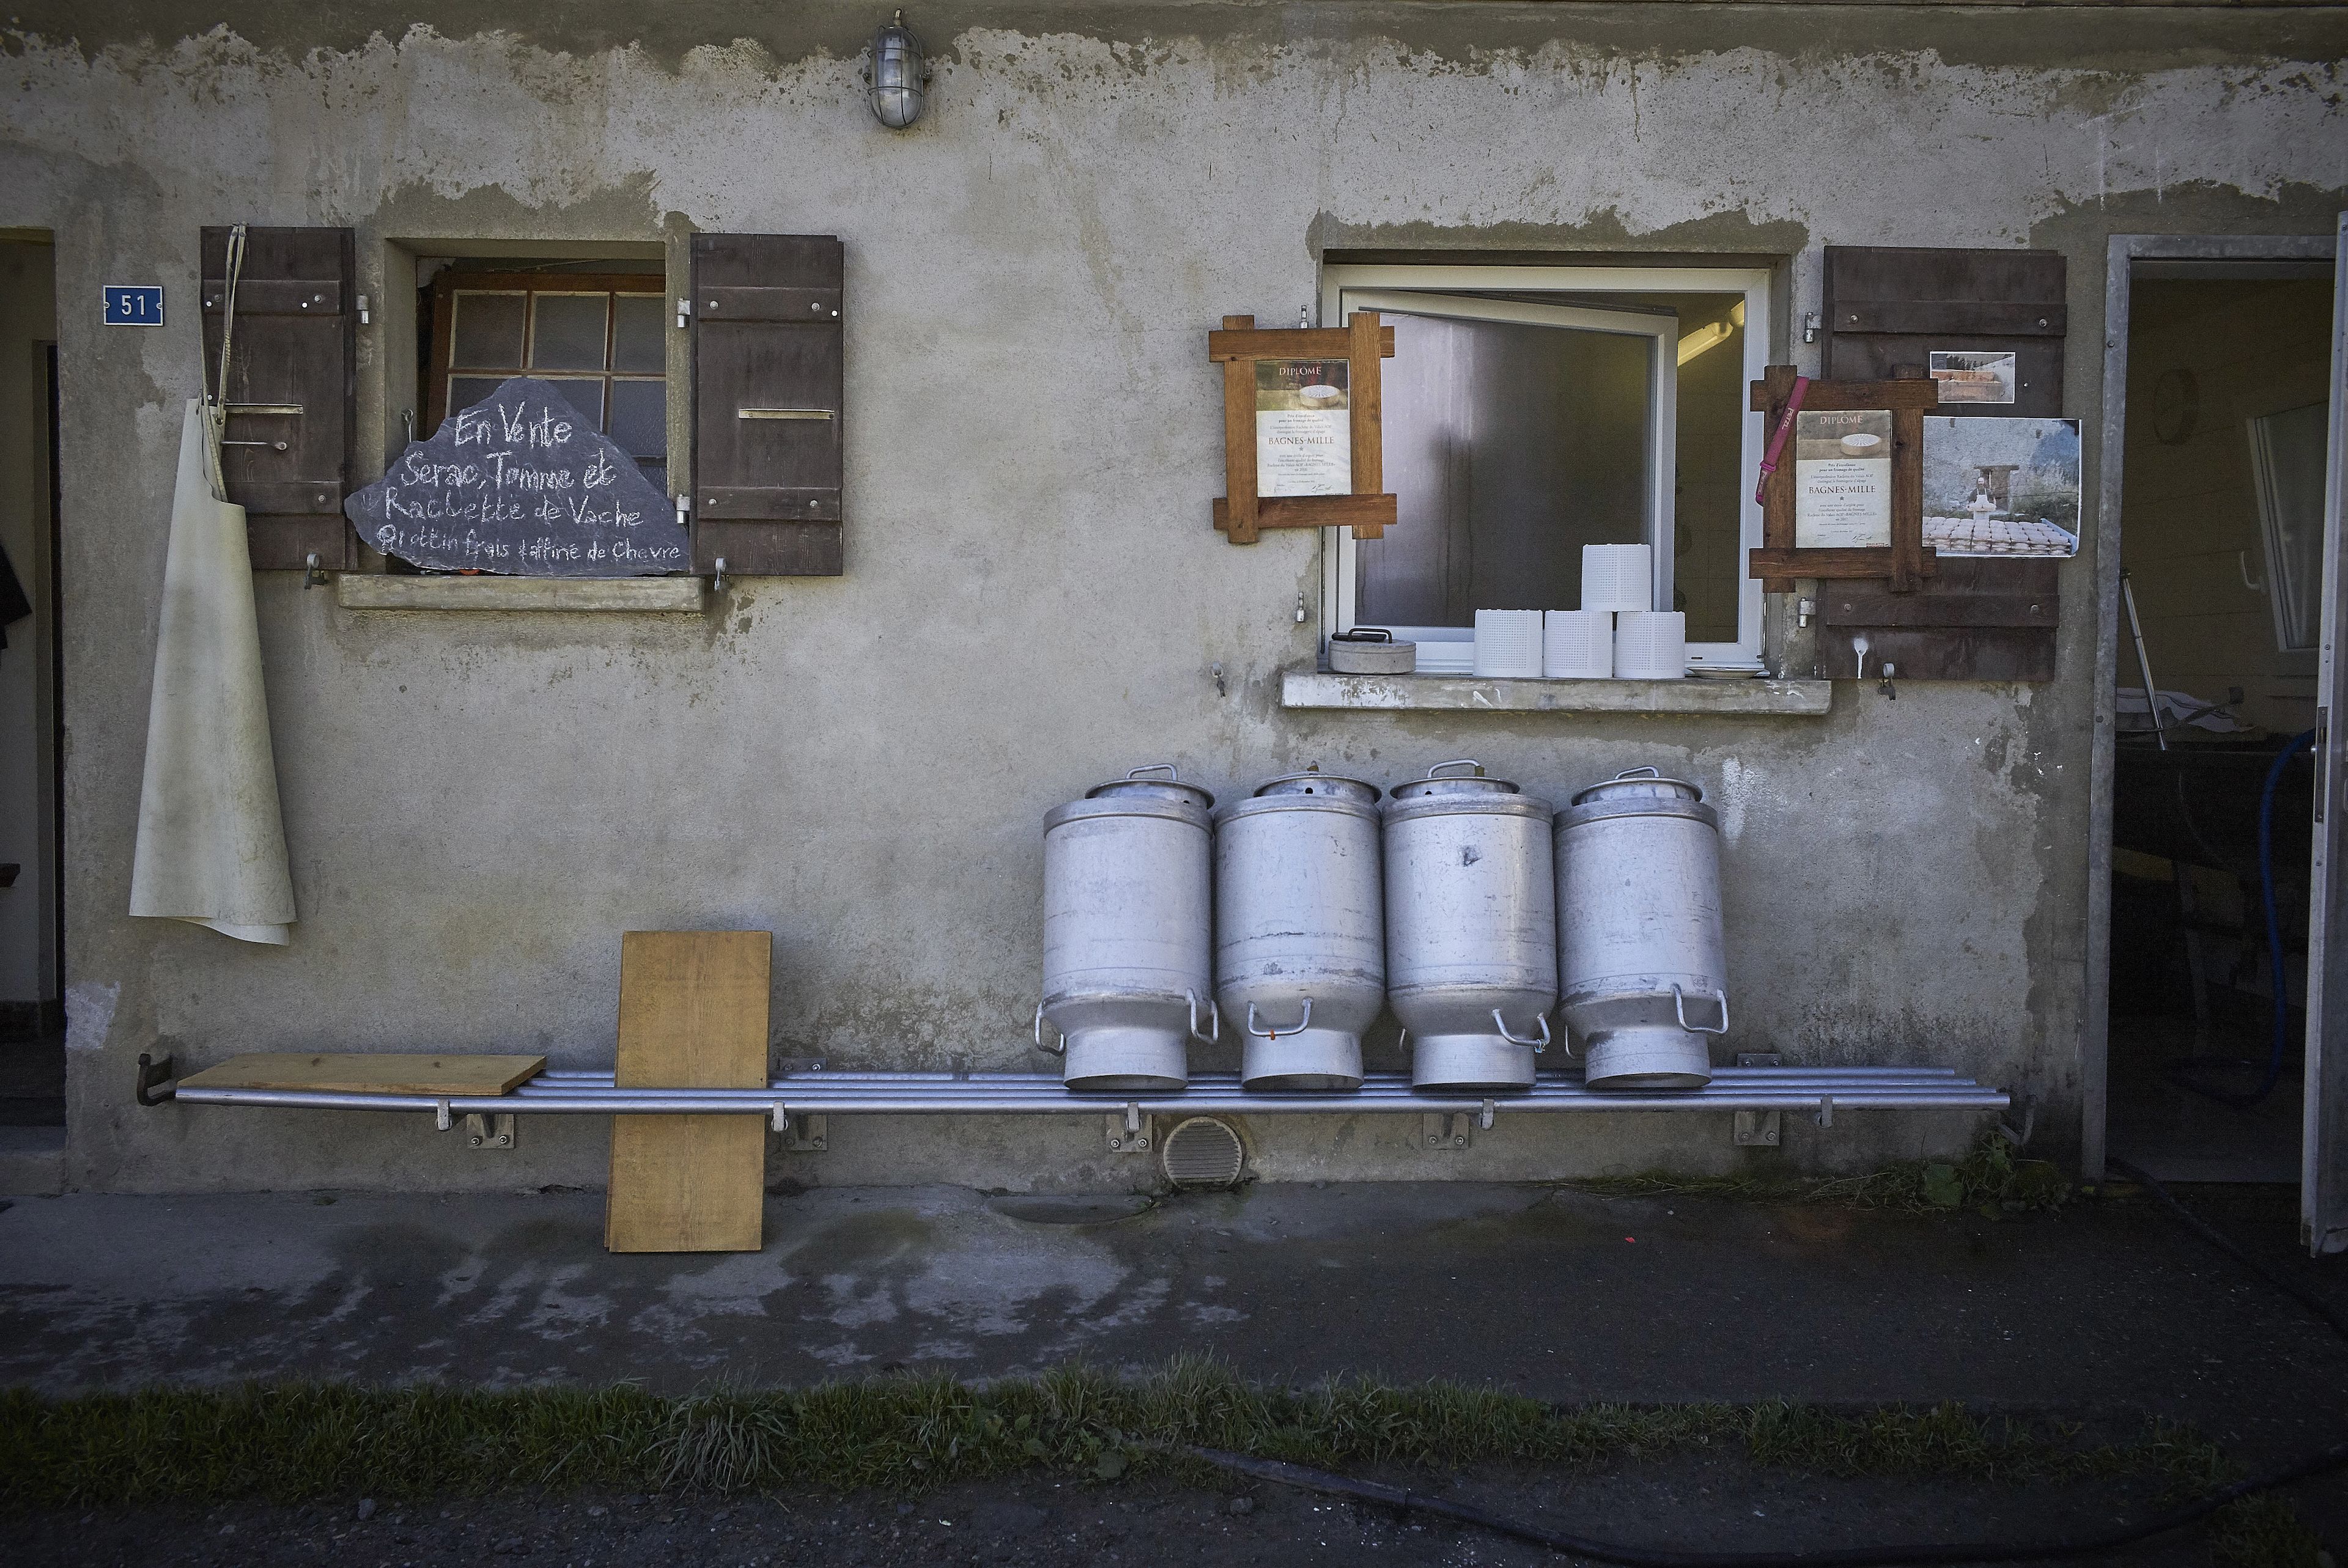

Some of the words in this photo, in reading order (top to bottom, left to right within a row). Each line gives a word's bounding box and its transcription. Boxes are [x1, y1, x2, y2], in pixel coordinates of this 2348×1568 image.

[122, 295, 144, 315] 51
[1279, 366, 1321, 375] DIPLÔME
[455, 408, 491, 447] En
[498, 401, 572, 449] Vente
[1782, 407, 1794, 430] PETZL
[1820, 414, 1864, 425] DIPLÔME
[486, 450, 574, 490] Tomme
[583, 447, 616, 488] et
[1809, 485, 1875, 493] BAGNES-MILLE
[385, 486, 525, 523] Raclette
[535, 495, 561, 526] de
[568, 495, 643, 527] Vache
[588, 540, 606, 561] de
